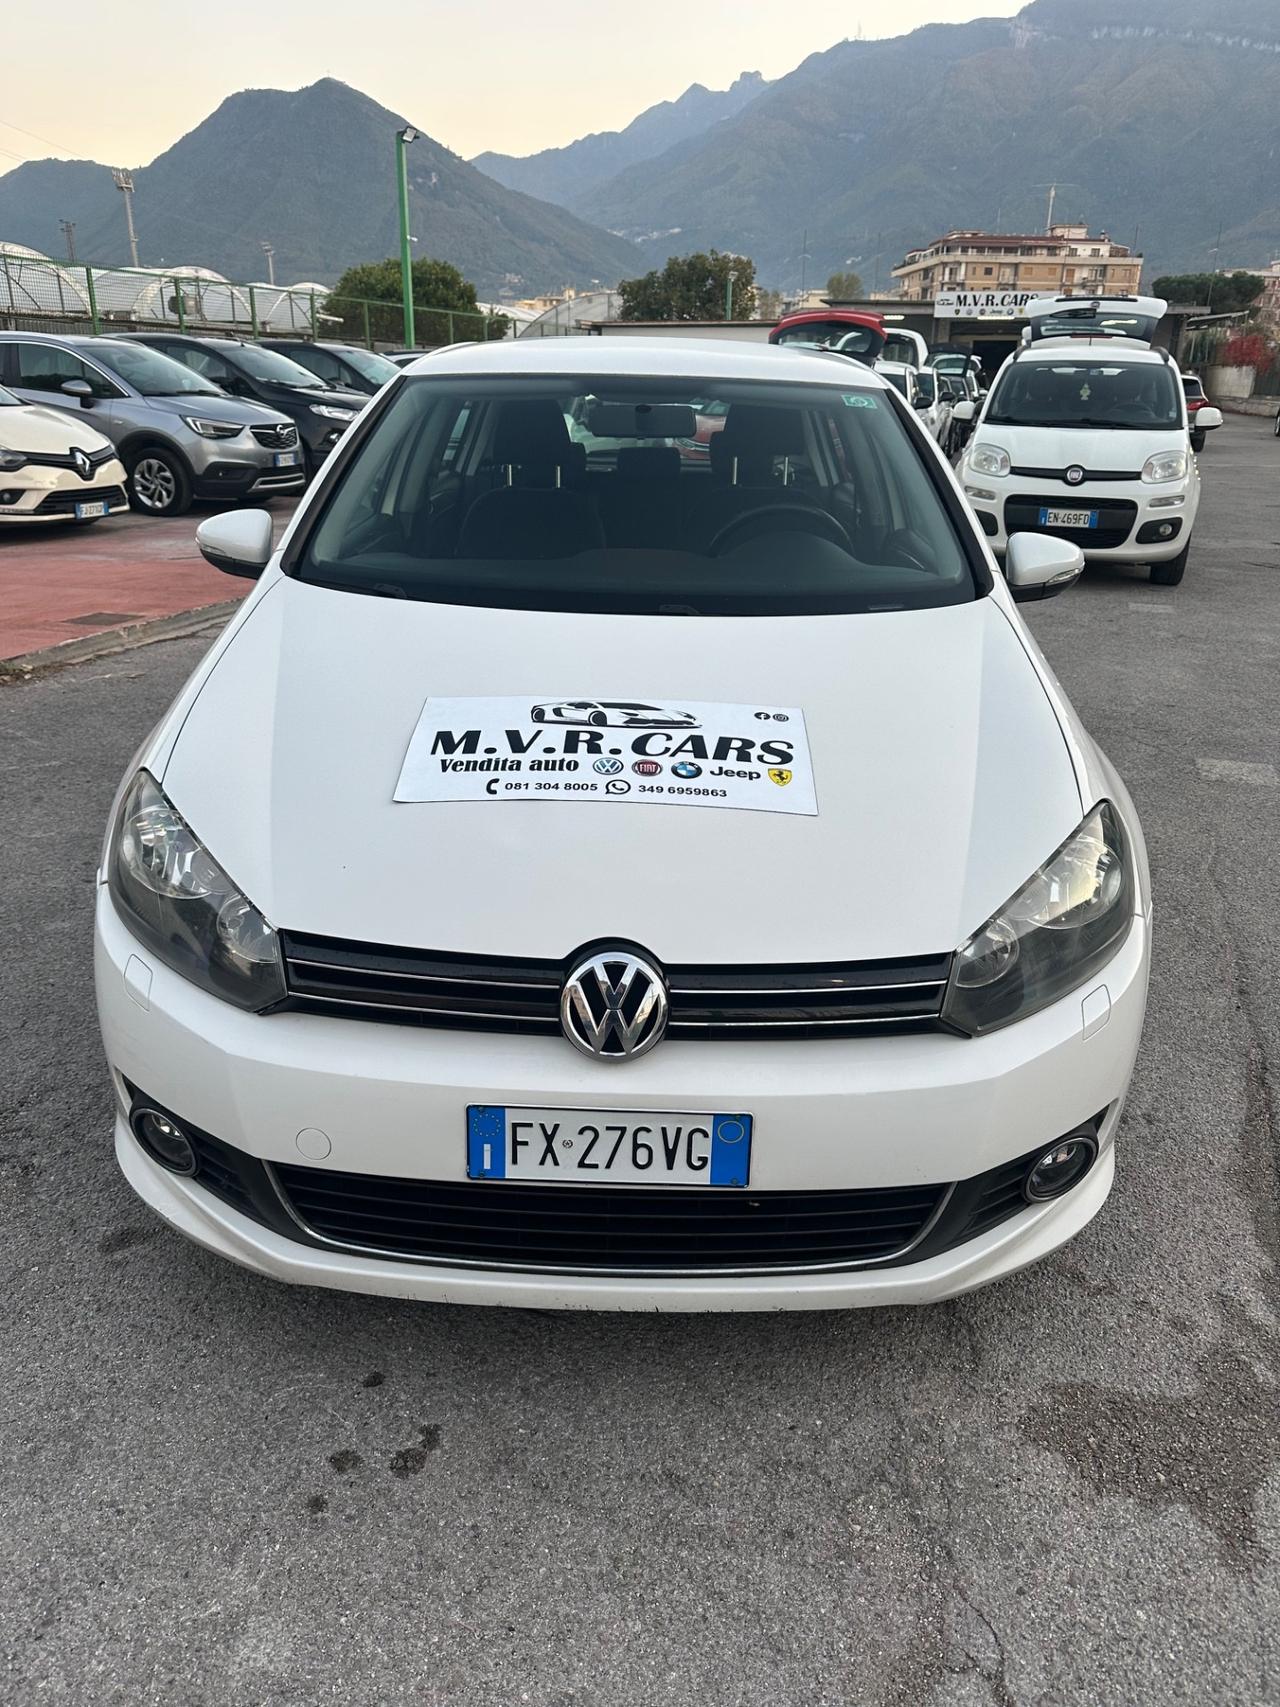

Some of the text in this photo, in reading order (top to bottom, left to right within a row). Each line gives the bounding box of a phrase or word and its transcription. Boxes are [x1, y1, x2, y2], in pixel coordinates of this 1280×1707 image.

[440, 757, 579, 773] Vendita auto
[639, 764, 657, 773] FIAT
[710, 766, 761, 781] Jeep
[504, 782, 598, 791] 081 304 8005
[638, 784, 727, 798] 349 6959863
